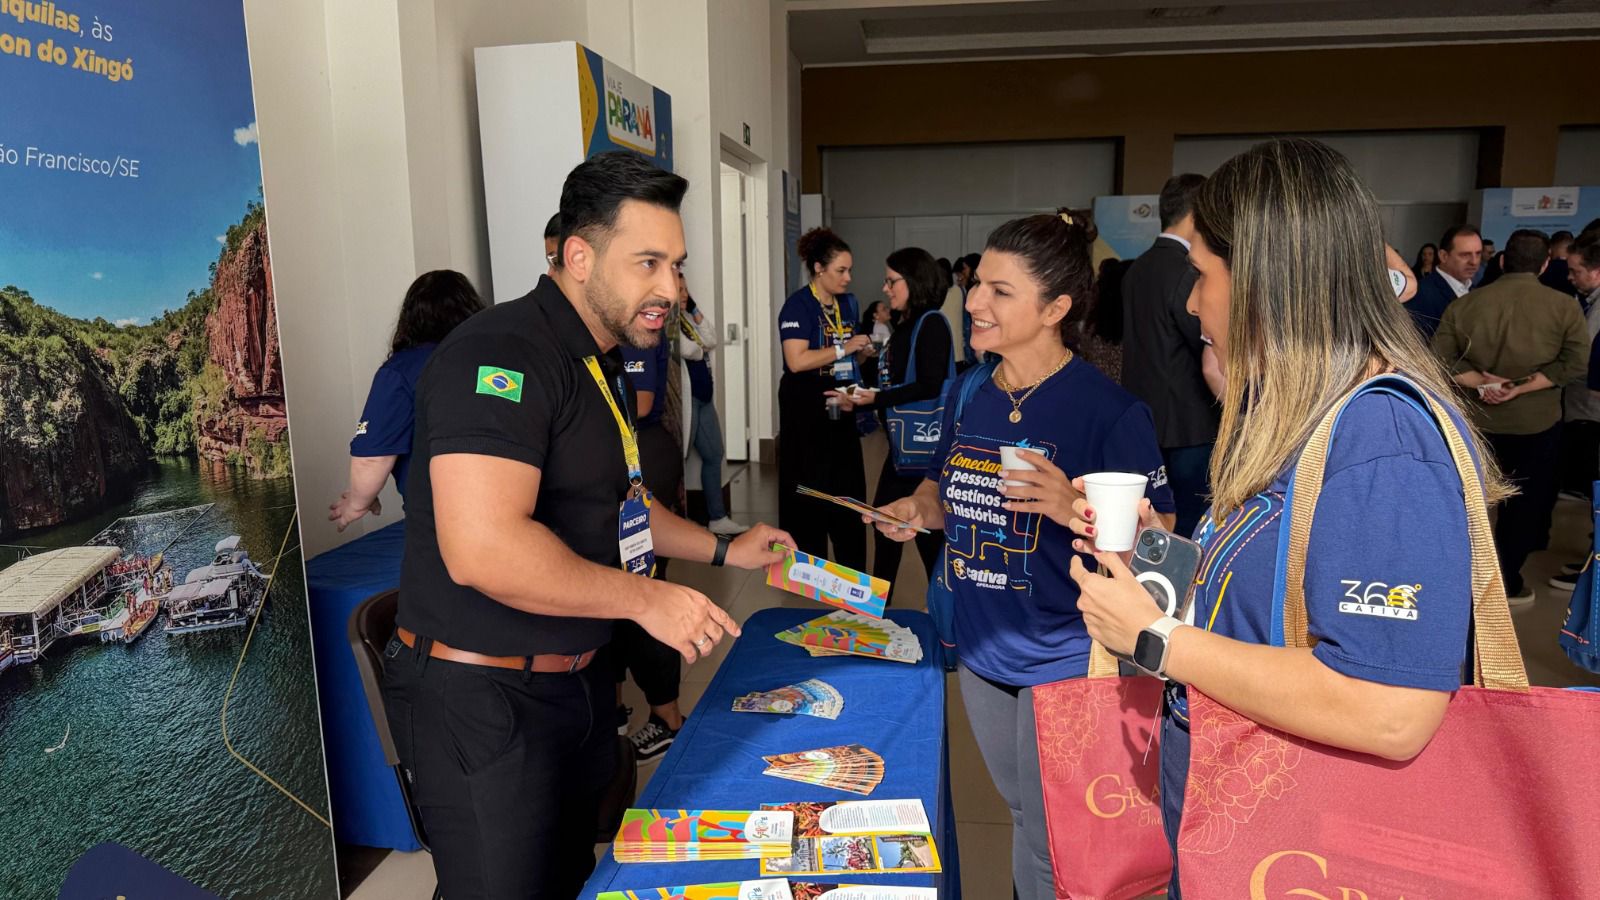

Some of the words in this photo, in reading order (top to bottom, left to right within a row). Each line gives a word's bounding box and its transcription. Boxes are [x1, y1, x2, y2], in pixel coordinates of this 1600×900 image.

[91, 16, 113, 42] às
[37, 39, 68, 66] do
[72, 46, 134, 82] Xingó
[608, 90, 653, 141] PARANÁ
[25, 147, 140, 178] Francisco/SE
[950, 471, 1005, 491] pessoas
[946, 485, 1001, 508] destinos
[623, 514, 647, 530] PARCEIRO
[952, 502, 1007, 526] histórias
[1341, 603, 1414, 618] CATIVA
